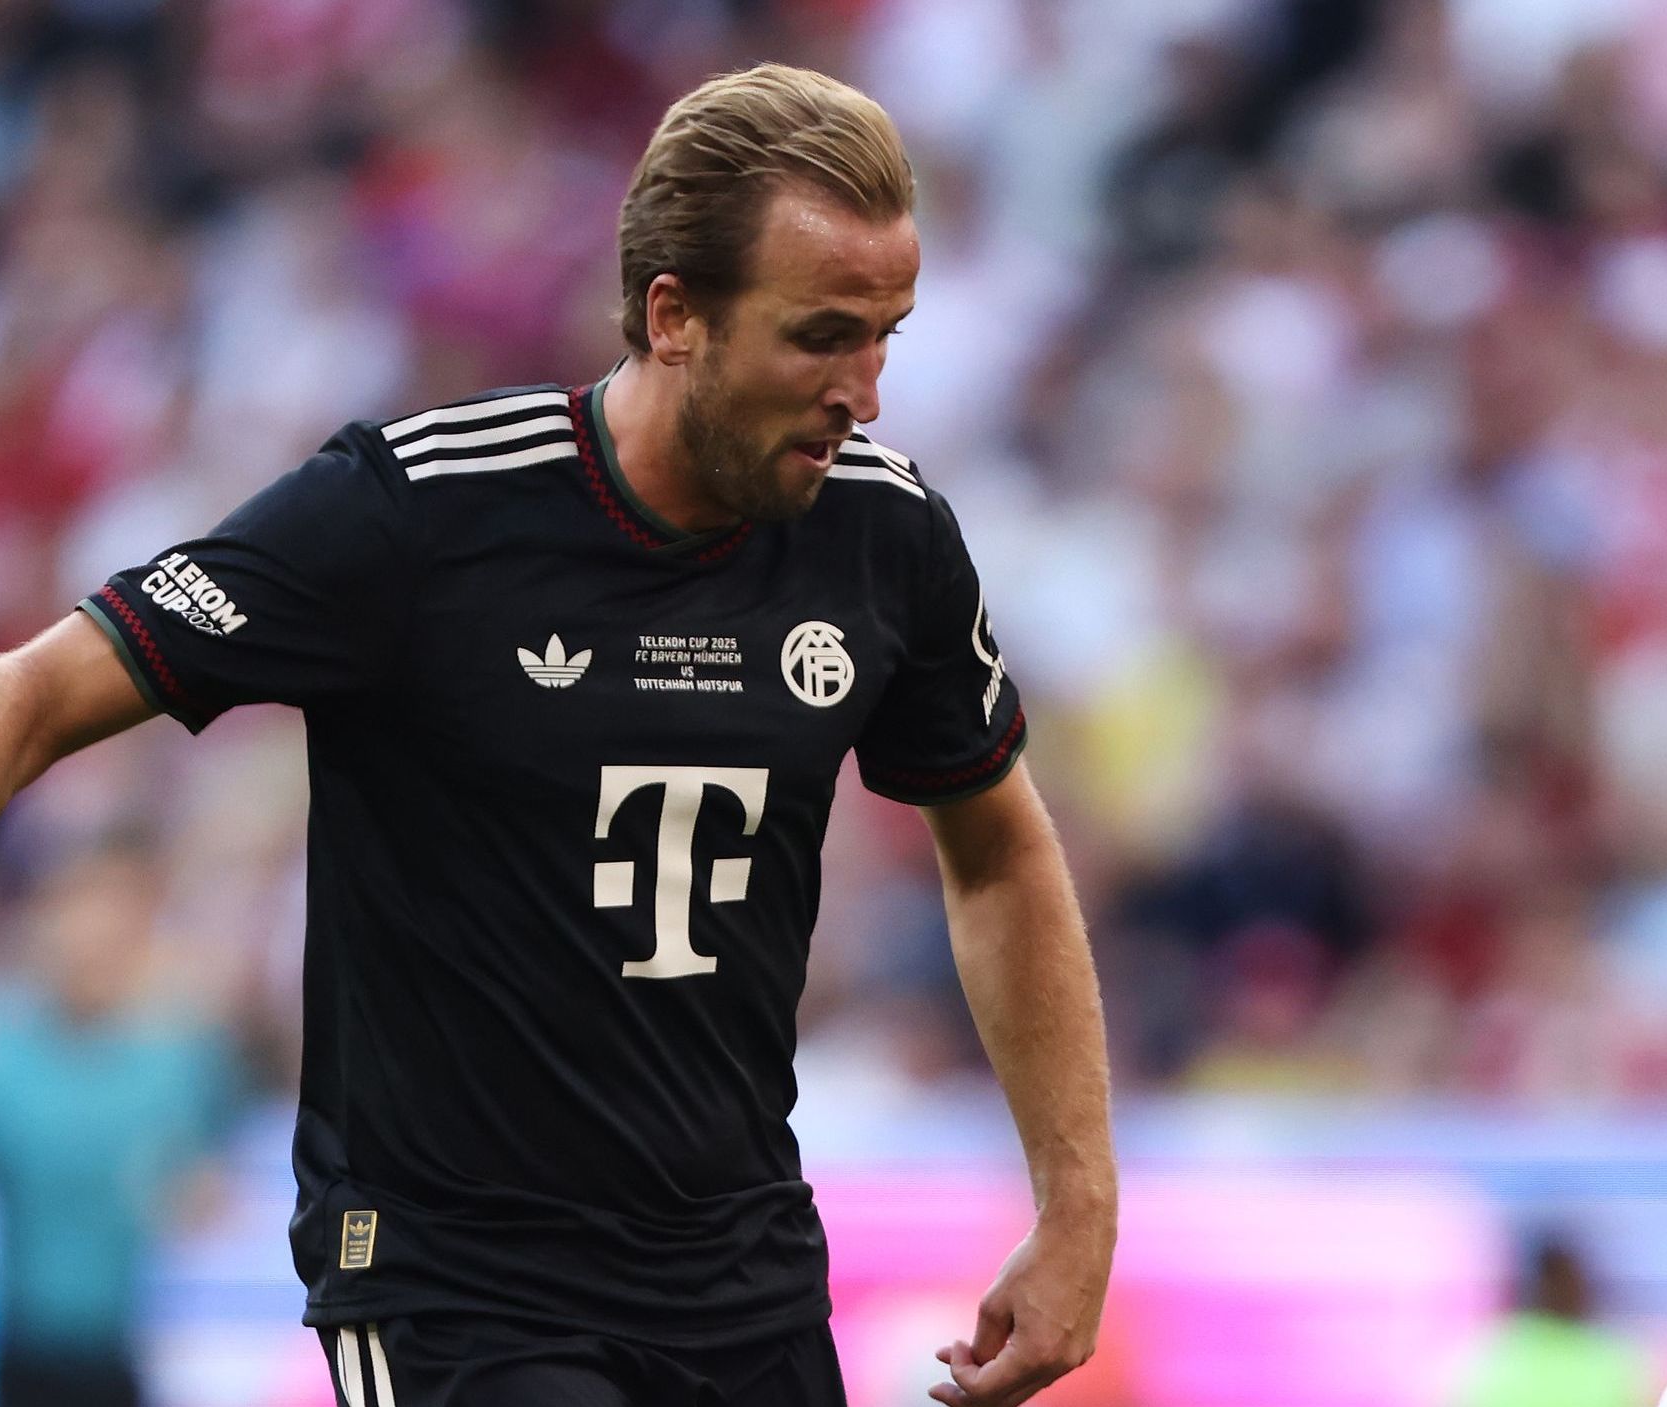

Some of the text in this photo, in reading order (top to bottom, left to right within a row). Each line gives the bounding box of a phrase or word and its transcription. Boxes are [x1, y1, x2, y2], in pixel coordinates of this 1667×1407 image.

[141, 570, 192, 613] CUP
[639, 635, 738, 649] TELEKOM CUP 2025
[635, 650, 742, 663] FC BAYERN MÜNCHEN
[634, 678, 744, 692] TOTTENHAM HOTSPUR
